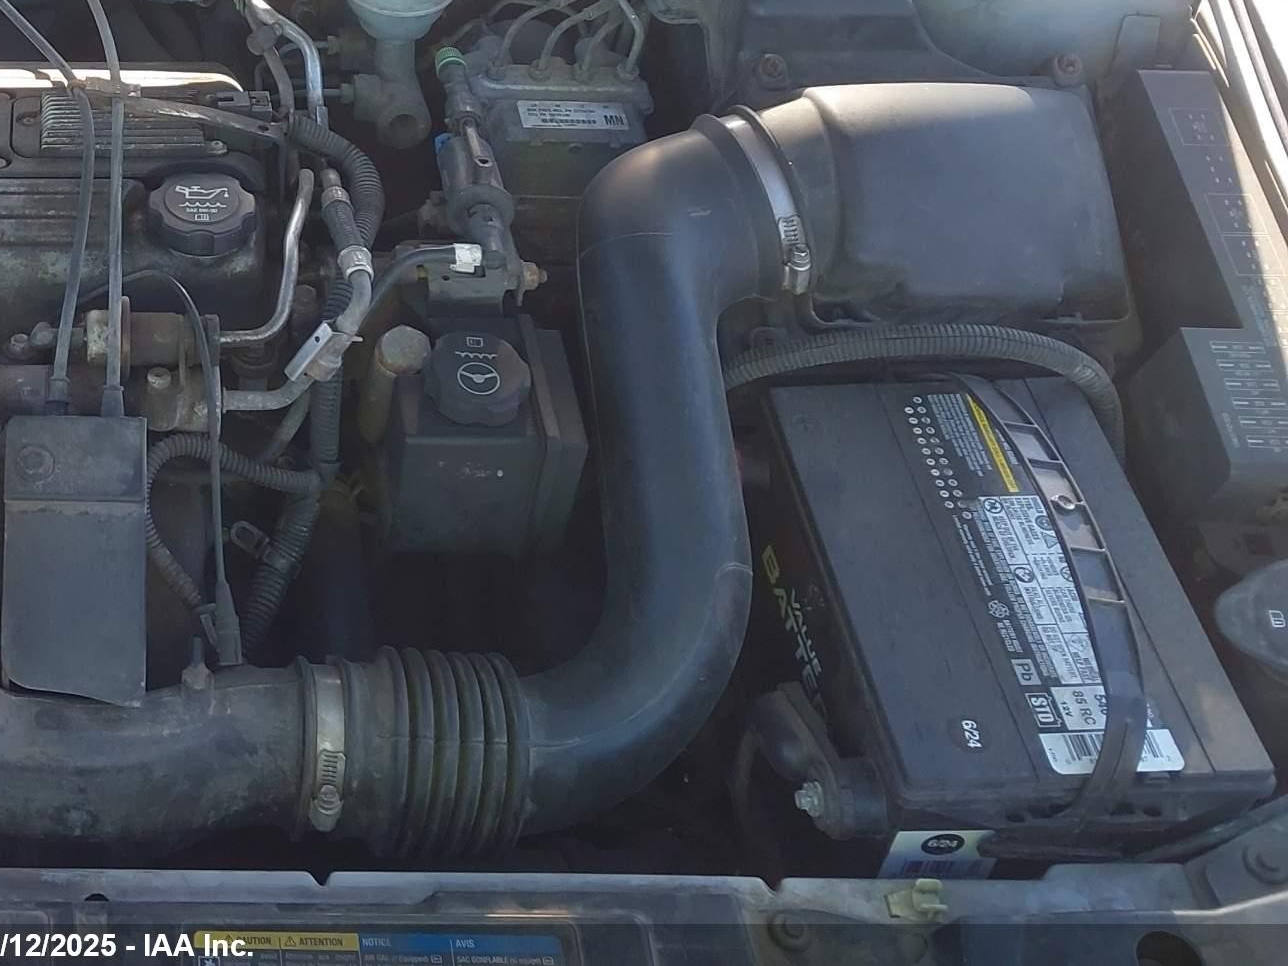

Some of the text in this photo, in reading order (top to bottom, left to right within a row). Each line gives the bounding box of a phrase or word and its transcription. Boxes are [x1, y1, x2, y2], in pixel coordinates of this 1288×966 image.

[603, 114, 625, 126] MN
[1016, 663, 1036, 681] Pb
[1029, 696, 1055, 722] STD
[1059, 701, 1074, 717] 12V
[1070, 690, 1097, 725] 85 RC
[961, 720, 982, 748] 6/24
[299, 937, 344, 947] ATTENTION
[362, 937, 392, 947] NOTICE
[455, 938, 476, 949] AVIS
